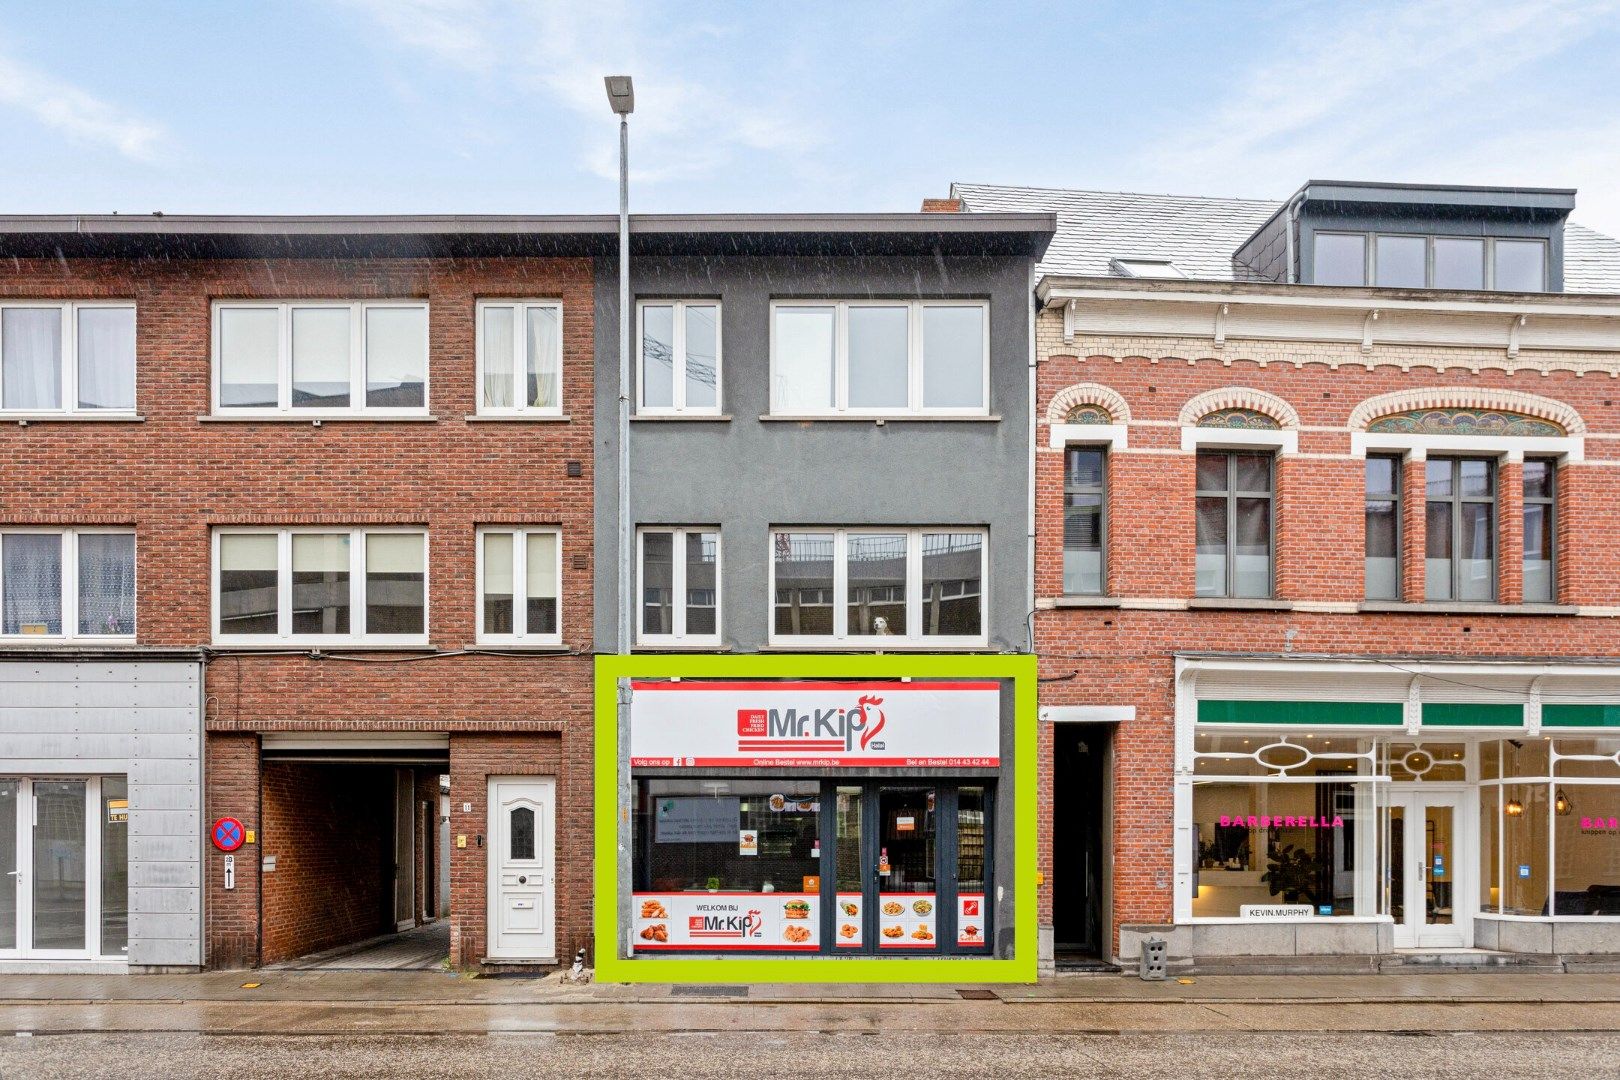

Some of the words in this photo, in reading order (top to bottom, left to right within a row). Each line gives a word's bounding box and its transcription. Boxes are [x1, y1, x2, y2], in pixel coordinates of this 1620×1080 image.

[633, 758, 648, 767] Volg
[662, 759, 670, 767] op
[753, 758, 774, 766] Online
[775, 758, 795, 766] Bestel
[796, 758, 840, 767] www.mrkip.be
[906, 758, 917, 766] Bel
[927, 758, 948, 766] Bestel
[949, 758, 961, 766] 014
[1220, 815, 1344, 828] BARBERELLA
[1249, 908, 1309, 917] KEVIN.MURPHY
